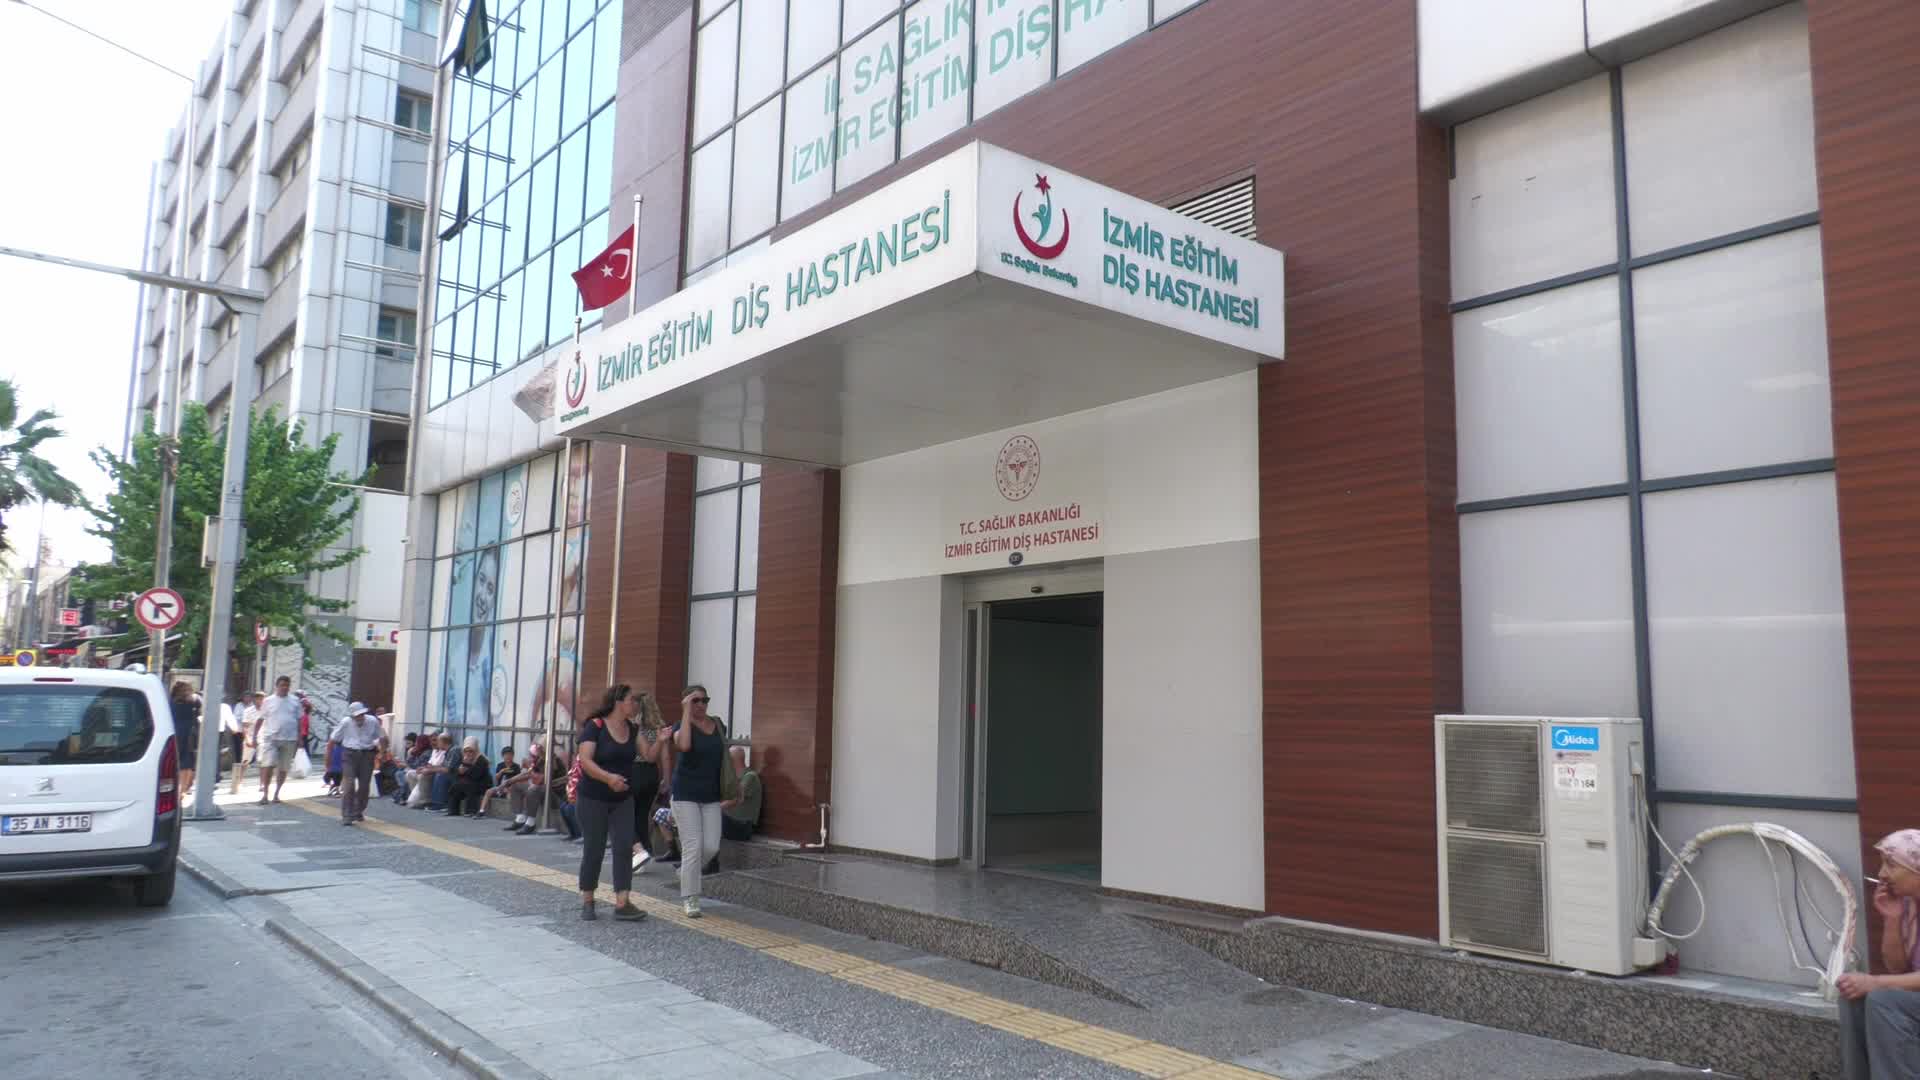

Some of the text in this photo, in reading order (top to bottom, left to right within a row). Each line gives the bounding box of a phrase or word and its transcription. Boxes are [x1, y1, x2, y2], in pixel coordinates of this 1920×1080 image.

[854, 0, 972, 95] SAĞLIK
[791, 115, 862, 185] İZMİR
[869, 45, 977, 142] EĞİTİM
[990, 4, 1051, 74] DİŞ
[1103, 207, 1238, 286] İZMİR EĞİTİM
[597, 189, 951, 393] İZMİR EĞİTİM DİŞ HASTANESİ
[1103, 253, 1259, 329] DİŞ HASTANESİ
[945, 522, 1099, 559] İZMİR EĞİTİM DİŞ HASTANESİ
[960, 503, 1081, 536] T.C. SAĞLIK BAKANLIĞI
[1559, 733, 1595, 745] Midea
[12, 815, 89, 831] 35 AN 3116
